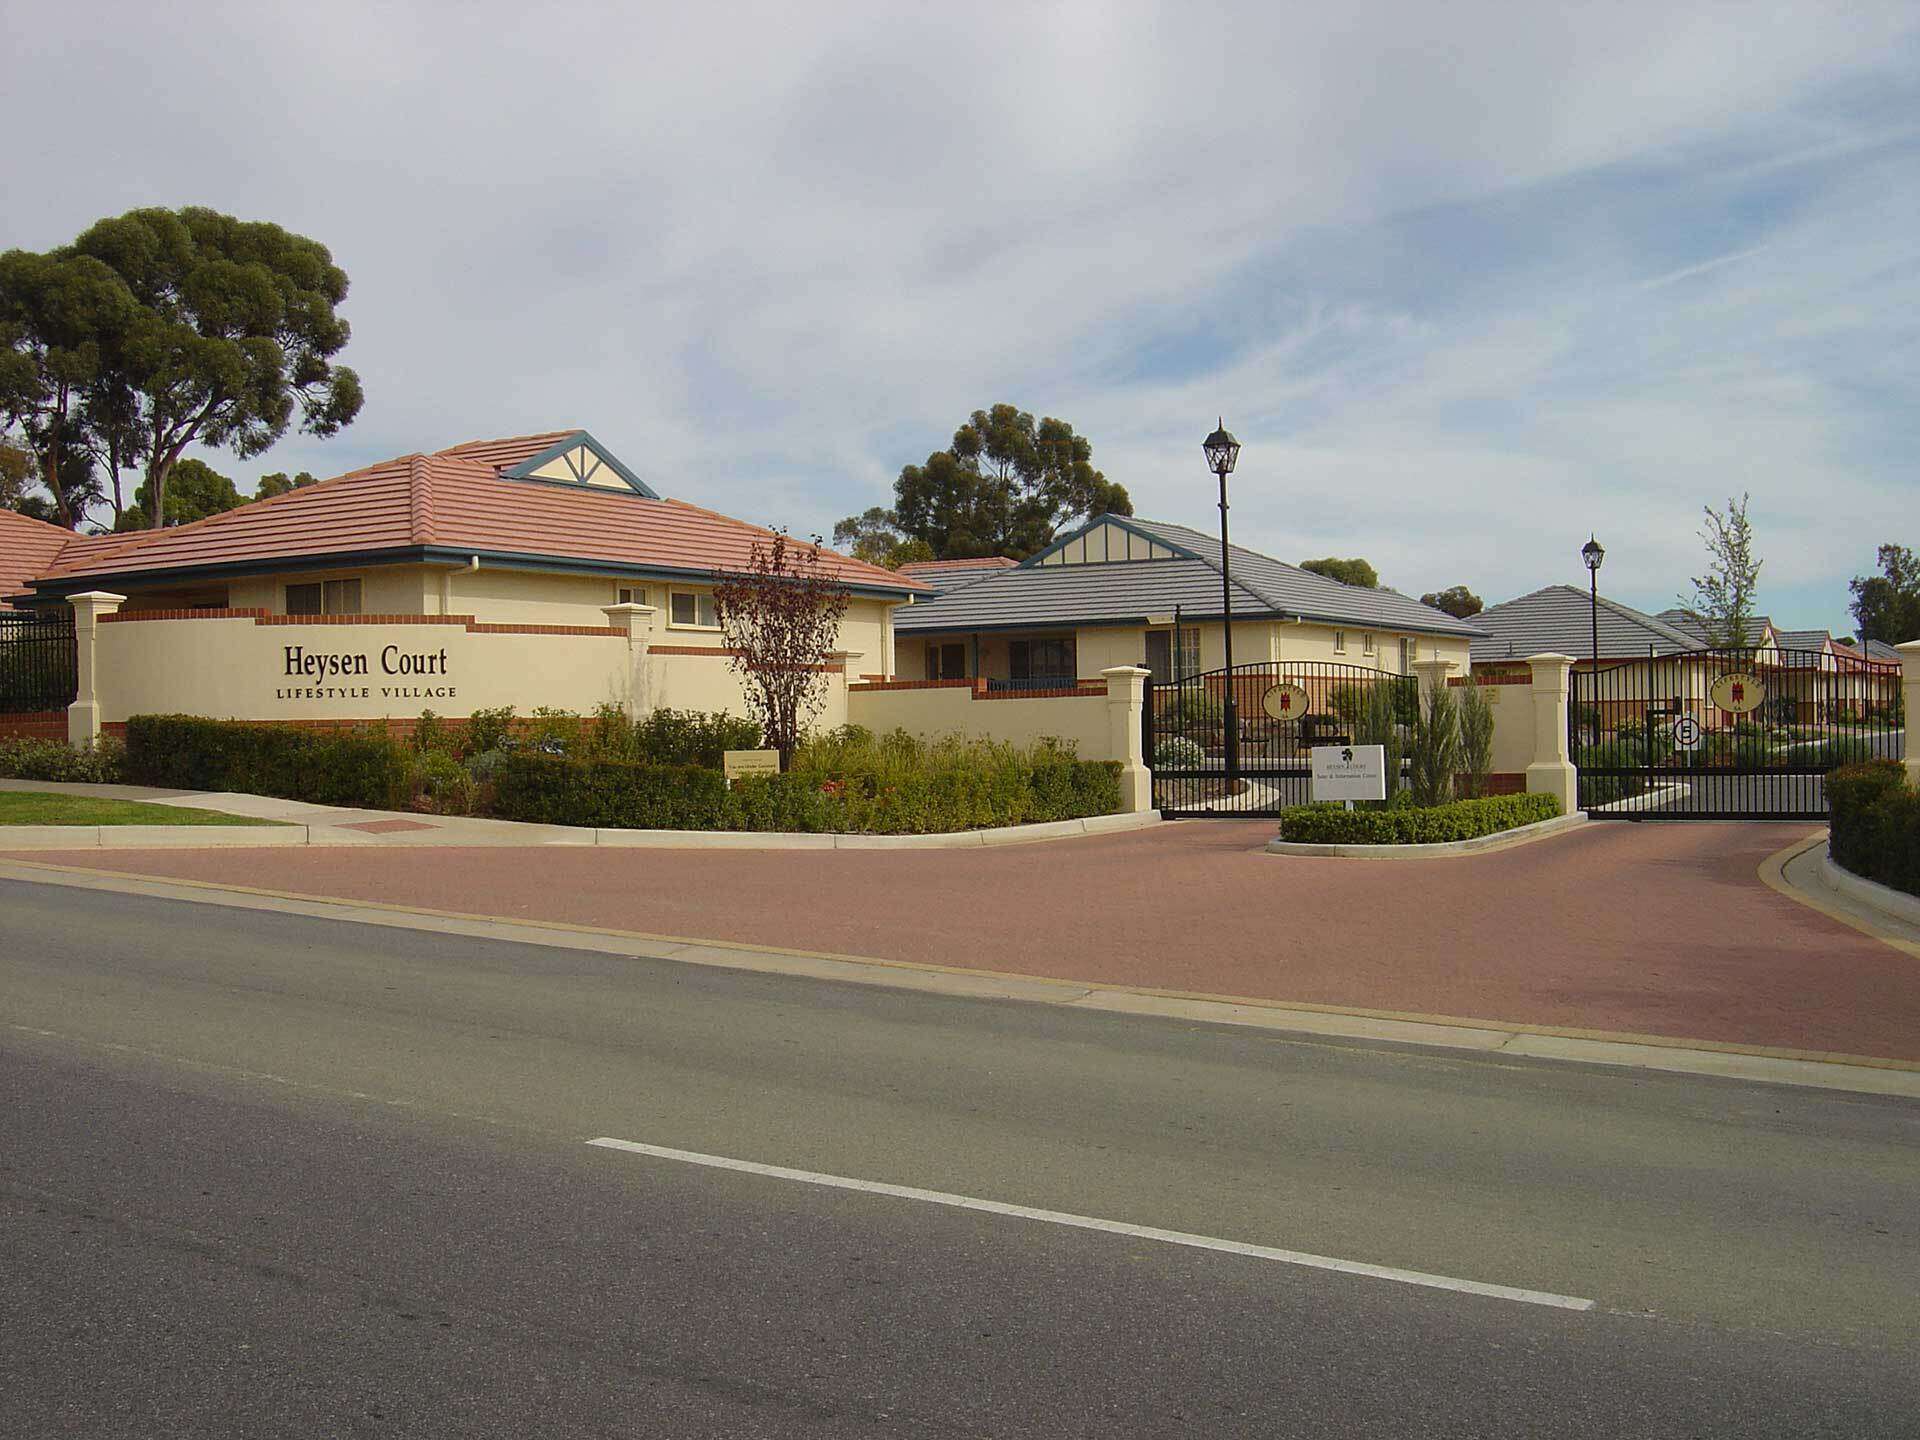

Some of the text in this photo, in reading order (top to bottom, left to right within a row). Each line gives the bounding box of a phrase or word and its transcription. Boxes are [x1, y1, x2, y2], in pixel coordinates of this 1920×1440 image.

[284, 644, 448, 685] Heysen Court
[276, 687, 457, 699] LIFESTYLE VILLAGE
